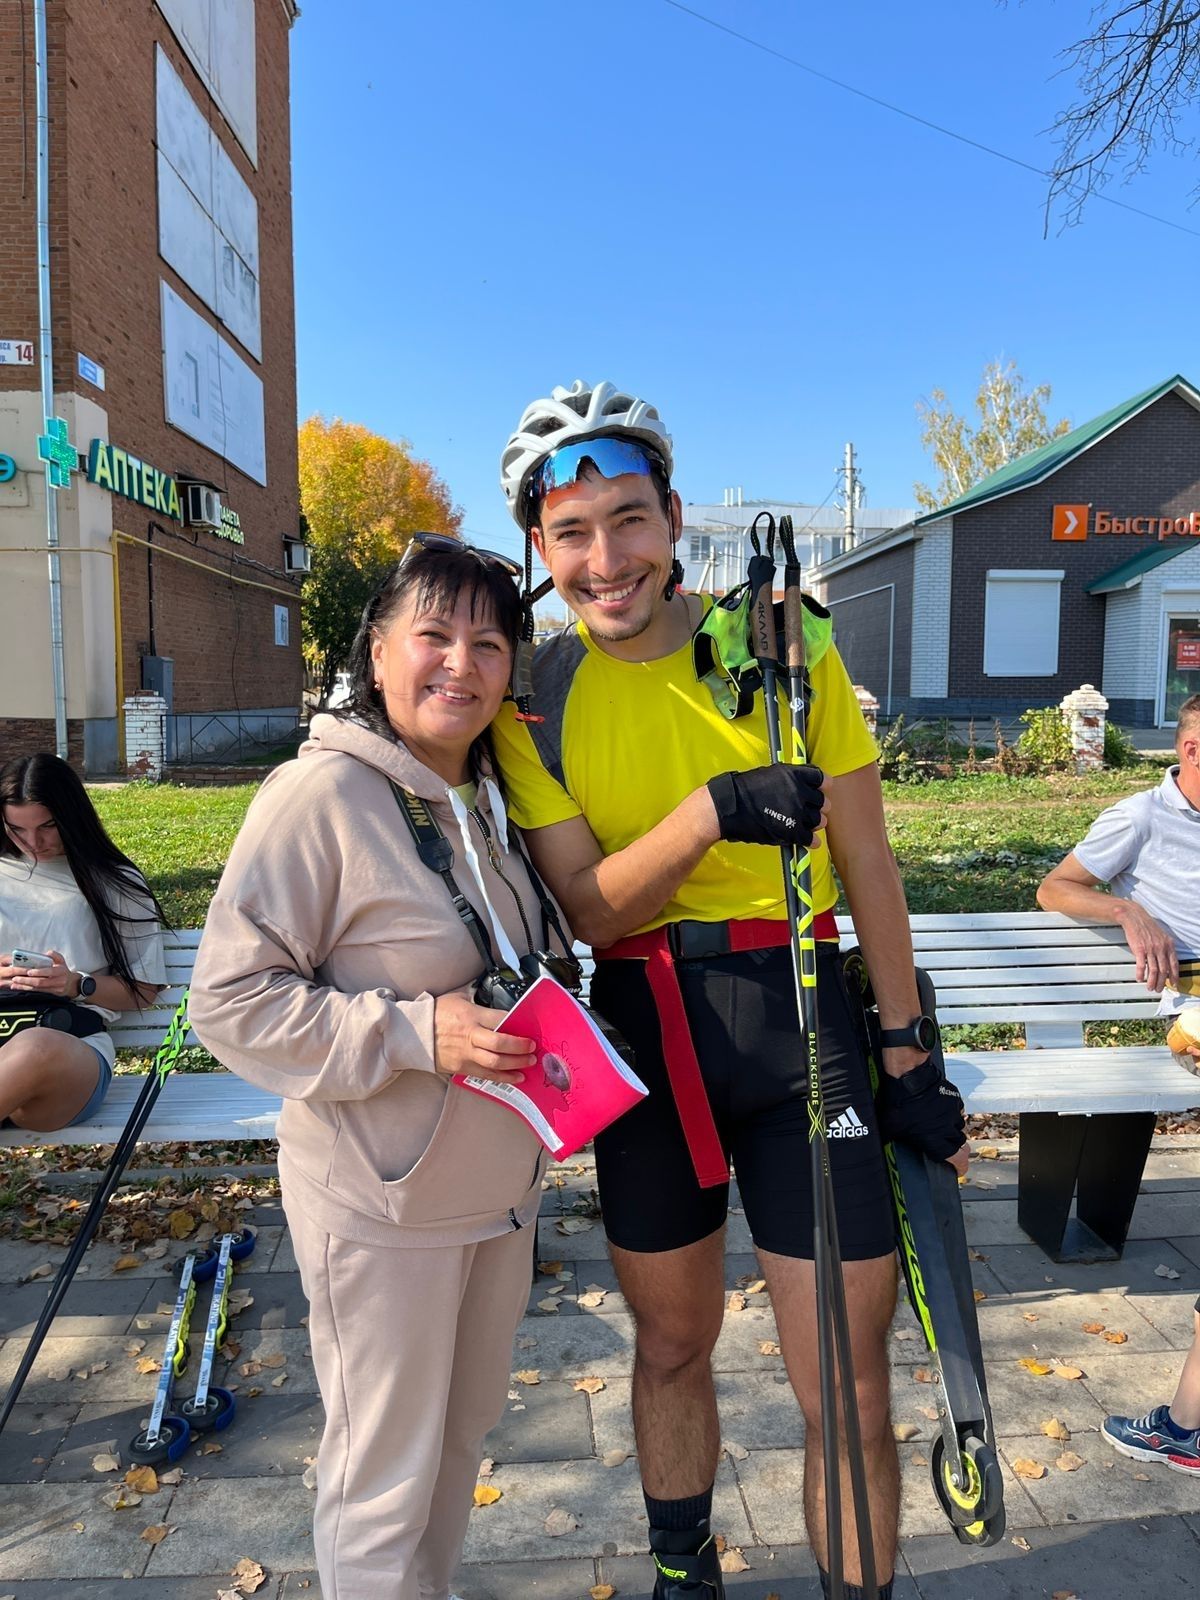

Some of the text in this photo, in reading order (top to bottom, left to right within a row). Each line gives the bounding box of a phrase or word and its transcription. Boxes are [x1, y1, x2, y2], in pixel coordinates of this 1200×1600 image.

[15, 344, 33, 361] 14
[94, 439, 182, 520] АПТЕКА
[209, 522, 245, 545] ДОРОВЬЯ
[808, 1032, 819, 1106] BLACKCODE
[826, 1126, 869, 1139] adidas
